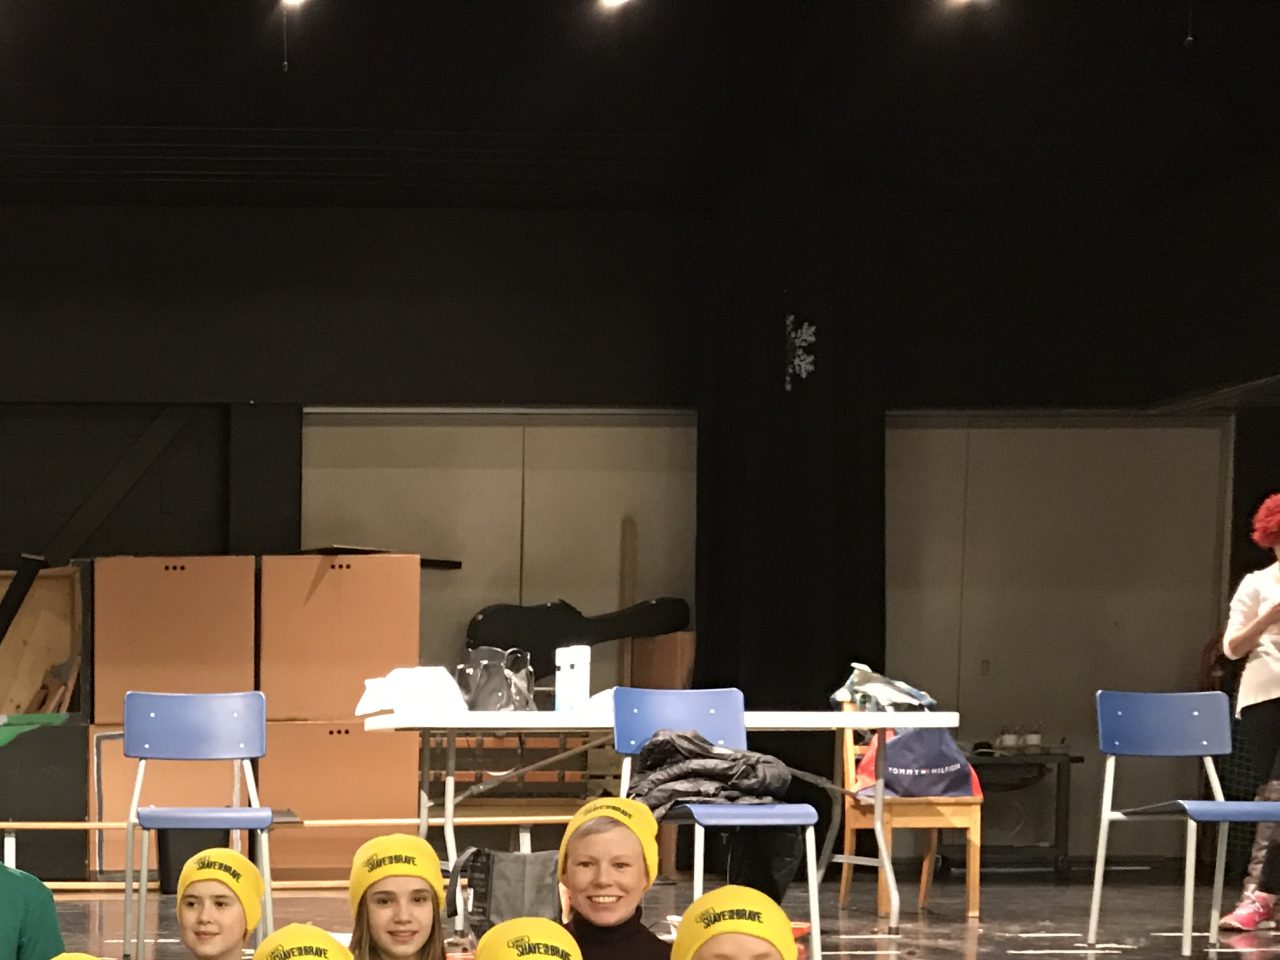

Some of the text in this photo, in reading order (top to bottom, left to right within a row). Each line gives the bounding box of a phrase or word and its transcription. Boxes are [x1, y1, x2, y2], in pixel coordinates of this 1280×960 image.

[888, 766, 919, 775] TOMMY
[703, 910, 729, 929] SHAVE
[303, 946, 329, 960] BRAVE
[516, 942, 542, 957] SHAVE
